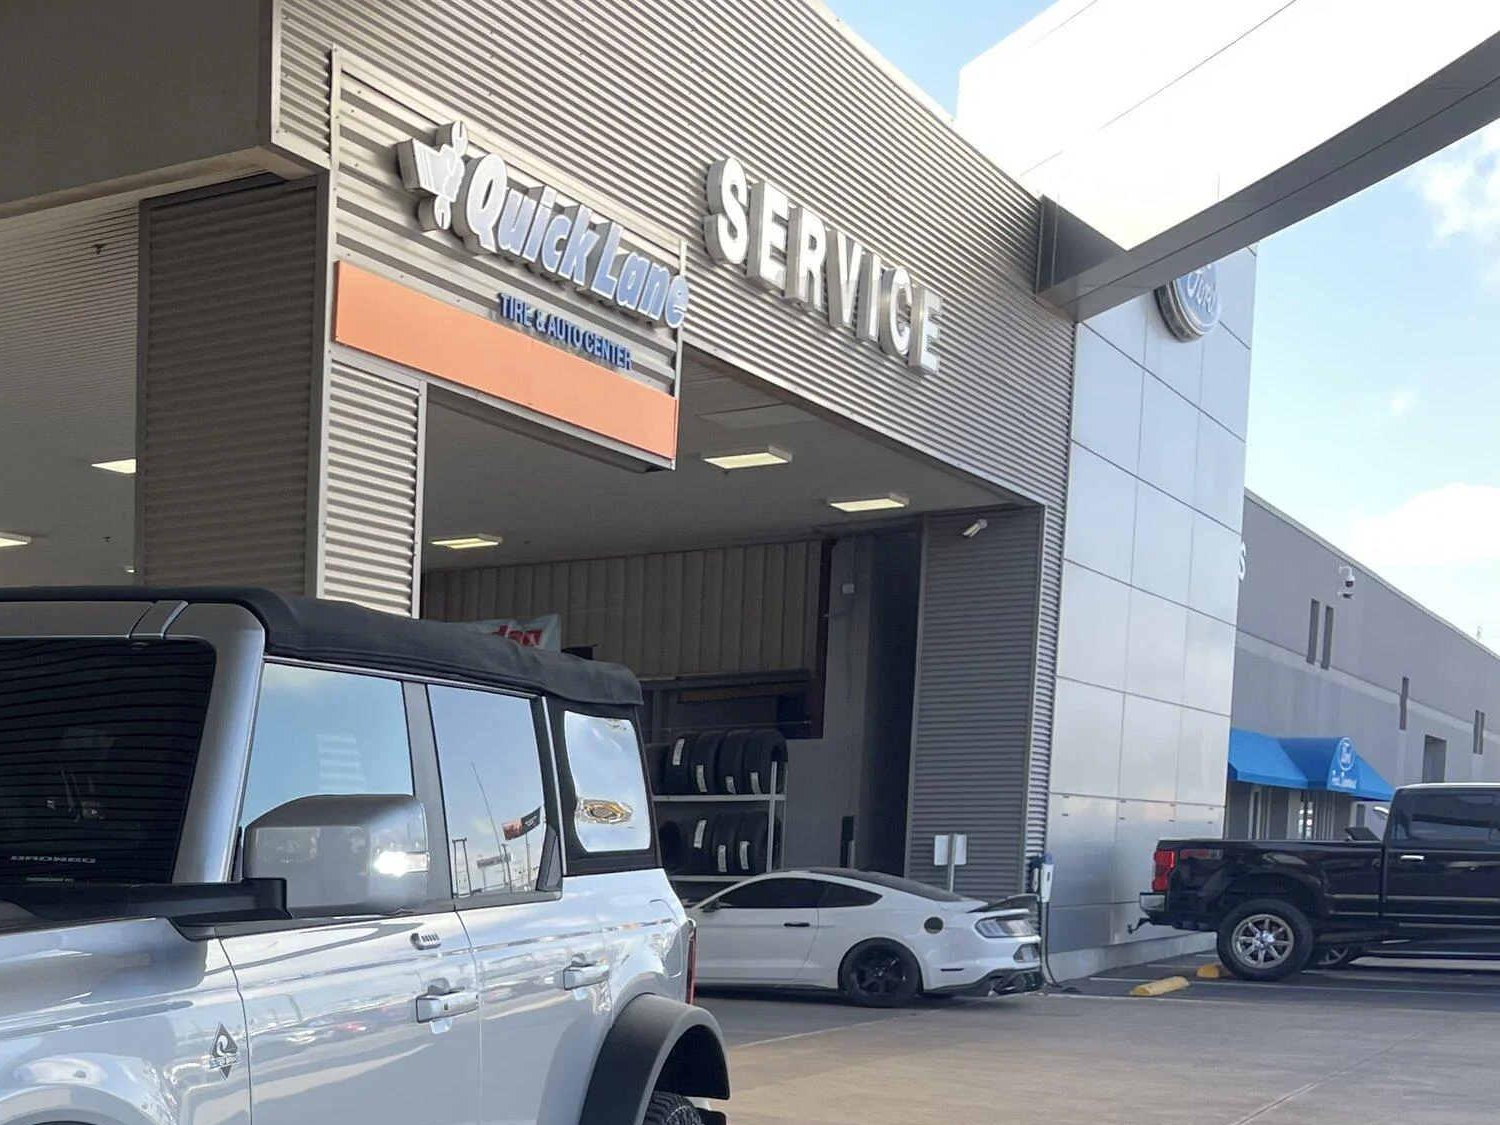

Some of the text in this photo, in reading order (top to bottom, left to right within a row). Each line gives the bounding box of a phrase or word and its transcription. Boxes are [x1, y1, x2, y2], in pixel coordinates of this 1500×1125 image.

[466, 153, 689, 328] Quick Lane
[704, 157, 943, 373] SERVICE
[500, 292, 633, 370] TIRE & AUTO CENTER
